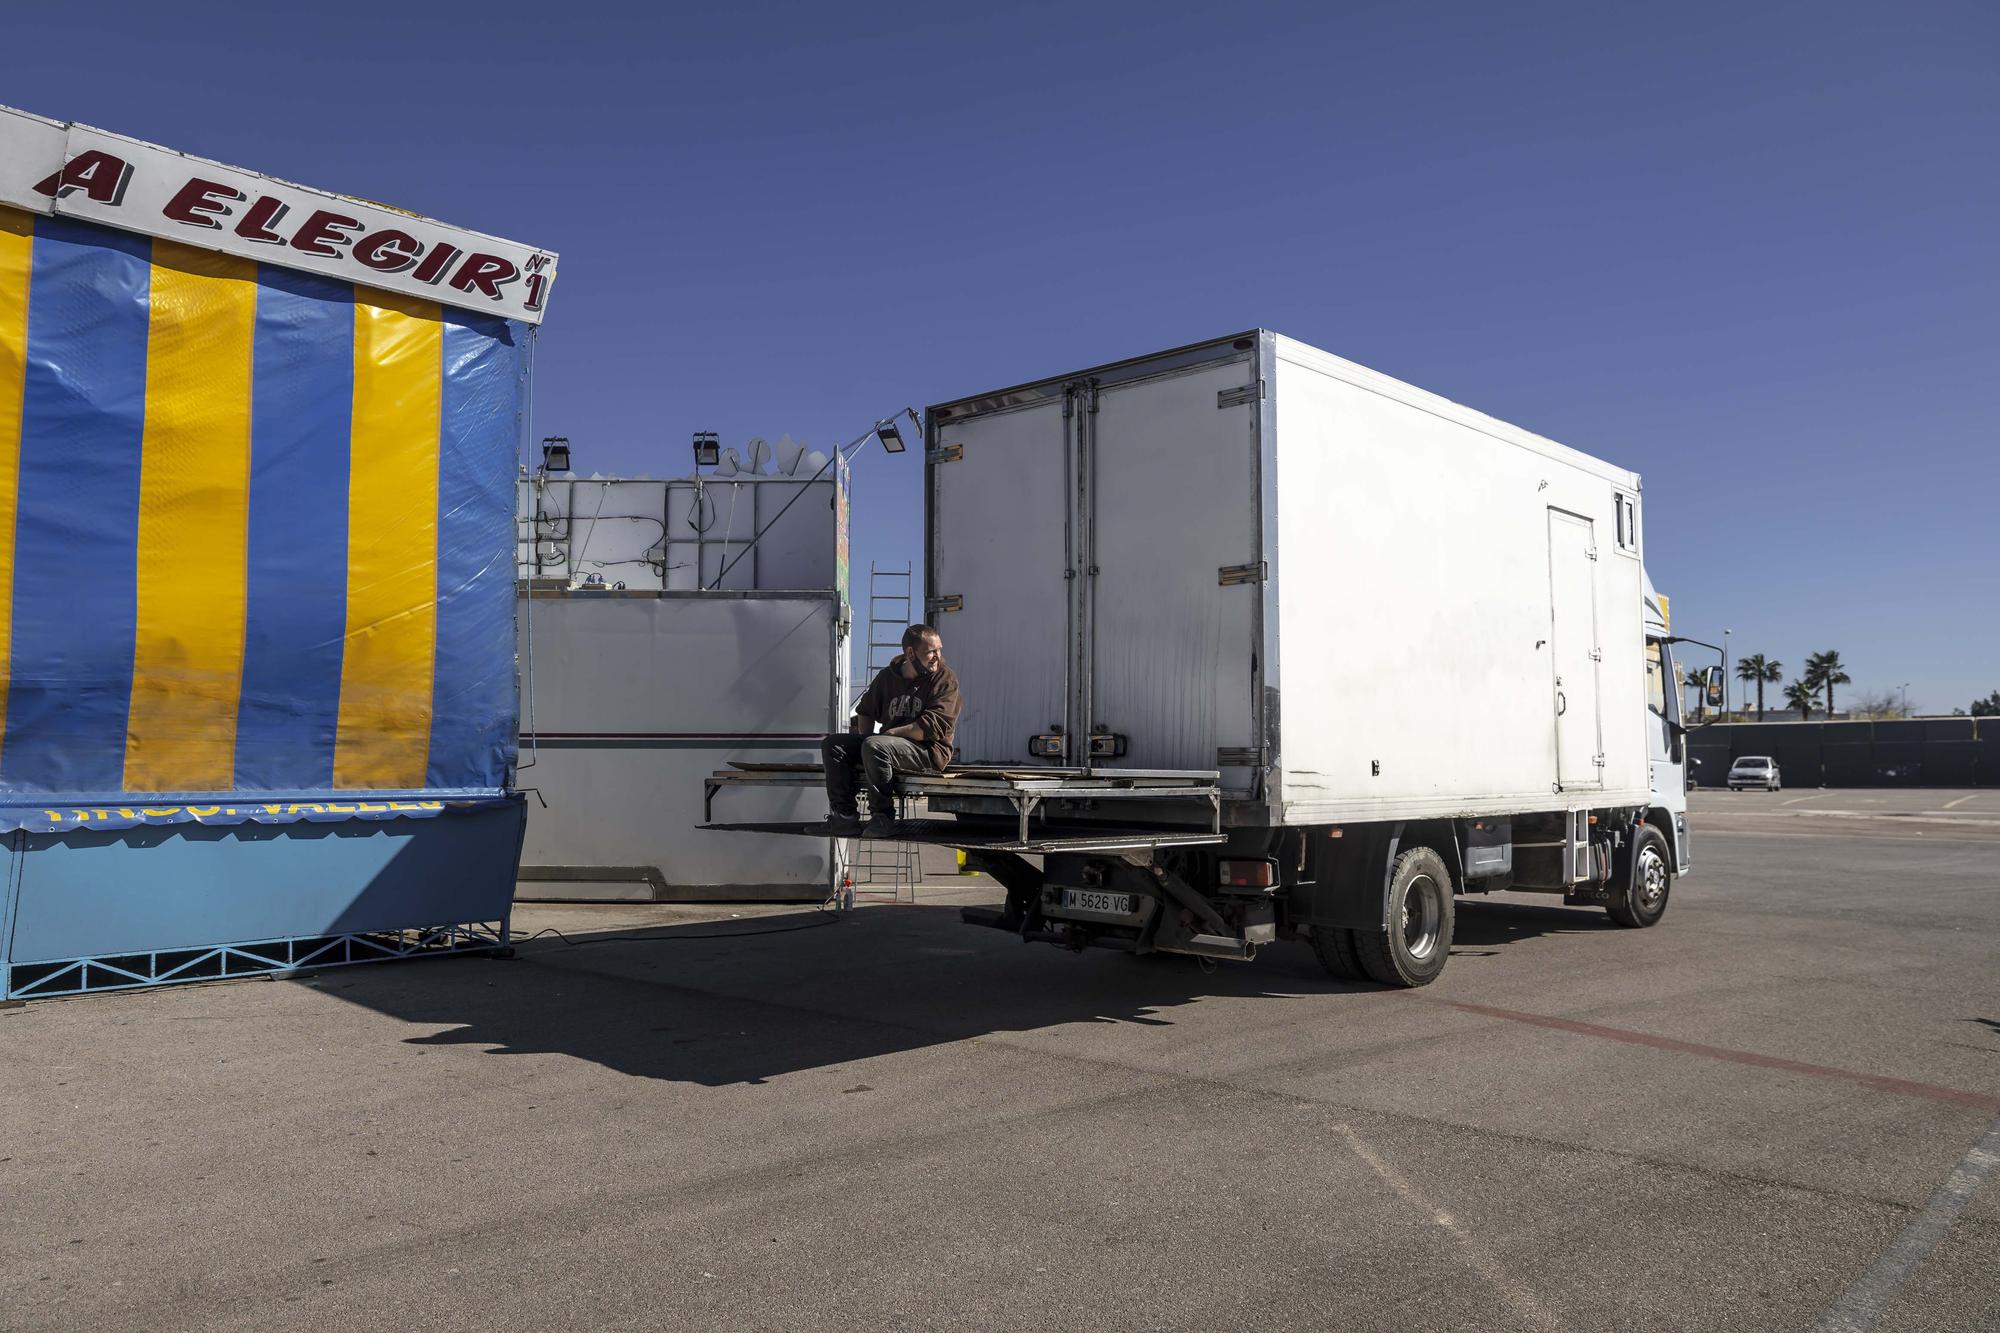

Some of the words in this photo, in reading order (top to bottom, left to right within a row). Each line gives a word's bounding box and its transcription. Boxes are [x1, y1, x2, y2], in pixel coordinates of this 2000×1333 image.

[33, 150, 135, 206] A
[162, 176, 522, 301] ELEGIR
[523, 273, 547, 312] 1
[888, 694, 922, 720] GAP
[1080, 893, 1109, 910] 5626
[1113, 896, 1128, 912] VG
